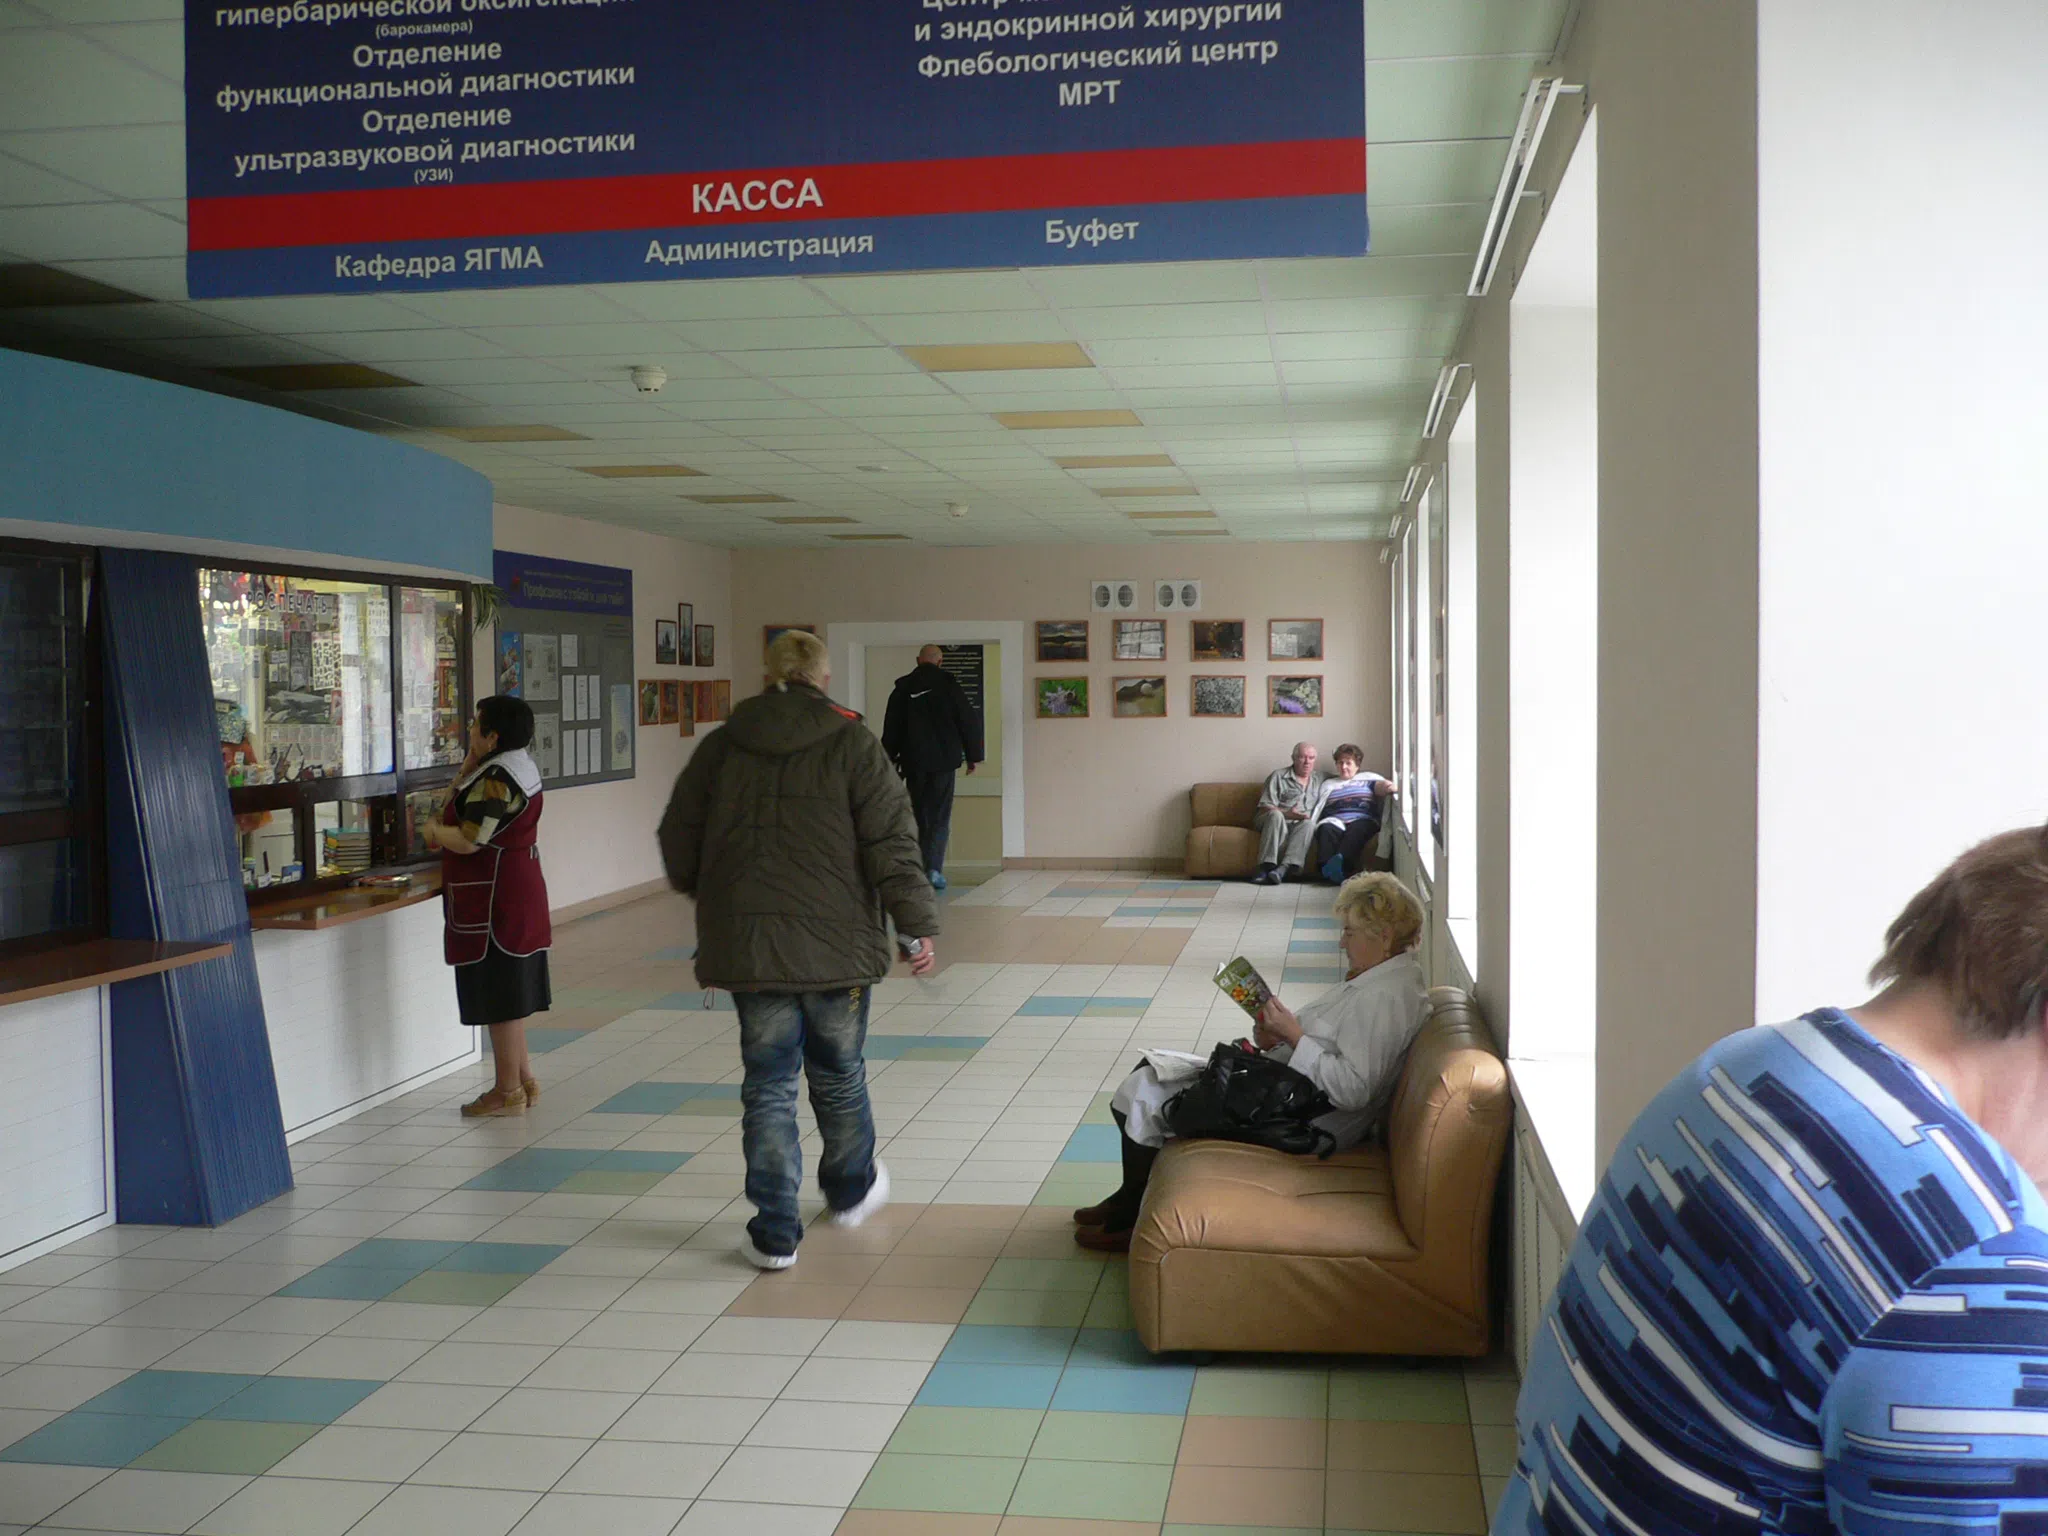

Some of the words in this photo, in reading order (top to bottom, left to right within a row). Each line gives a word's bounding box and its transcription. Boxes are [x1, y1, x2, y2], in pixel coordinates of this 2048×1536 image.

[217, 0, 452, 28] гипербарической
[376, 20, 472, 39] (барокамера)
[915, 24, 930, 41] и
[940, 5, 1134, 40] эндокринной
[1144, 2, 1281, 31] хирургии
[353, 43, 501, 69] Отделение
[918, 41, 1181, 77] Флебологический
[1192, 40, 1278, 66] центр
[217, 72, 453, 112] функциональной
[461, 67, 634, 94] диагностики
[1059, 80, 1121, 106] МРТ
[363, 108, 511, 134] Отделение
[235, 138, 453, 177] ультразвуковой
[461, 134, 634, 163] диагностики
[415, 168, 453, 184] (УЗИ)
[692, 178, 823, 213] КАССА
[1046, 218, 1139, 249] Буфет
[335, 254, 455, 281] Кафедра
[464, 246, 543, 271] ЯГМА
[645, 235, 874, 266] Администрация
[247, 591, 328, 614] РОСПЕЧАТЬ
